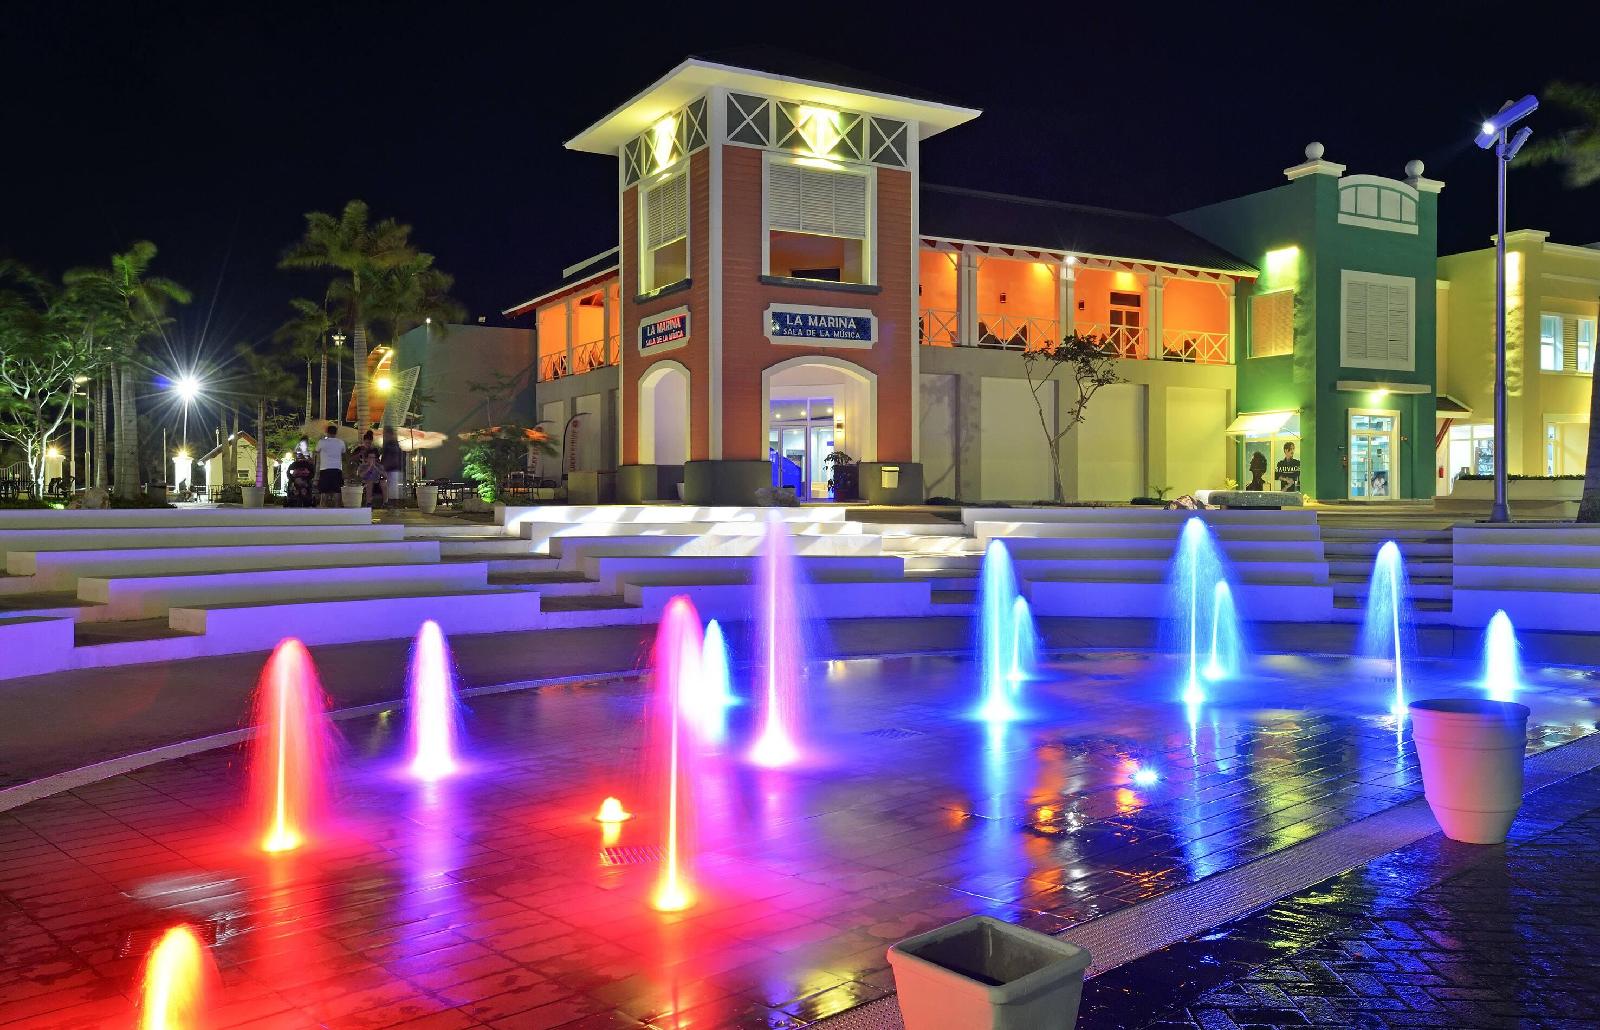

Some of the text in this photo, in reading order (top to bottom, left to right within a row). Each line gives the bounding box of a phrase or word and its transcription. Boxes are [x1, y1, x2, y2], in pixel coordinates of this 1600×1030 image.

[786, 314, 856, 328] LA MARINA
[783, 328, 803, 336] SALA
